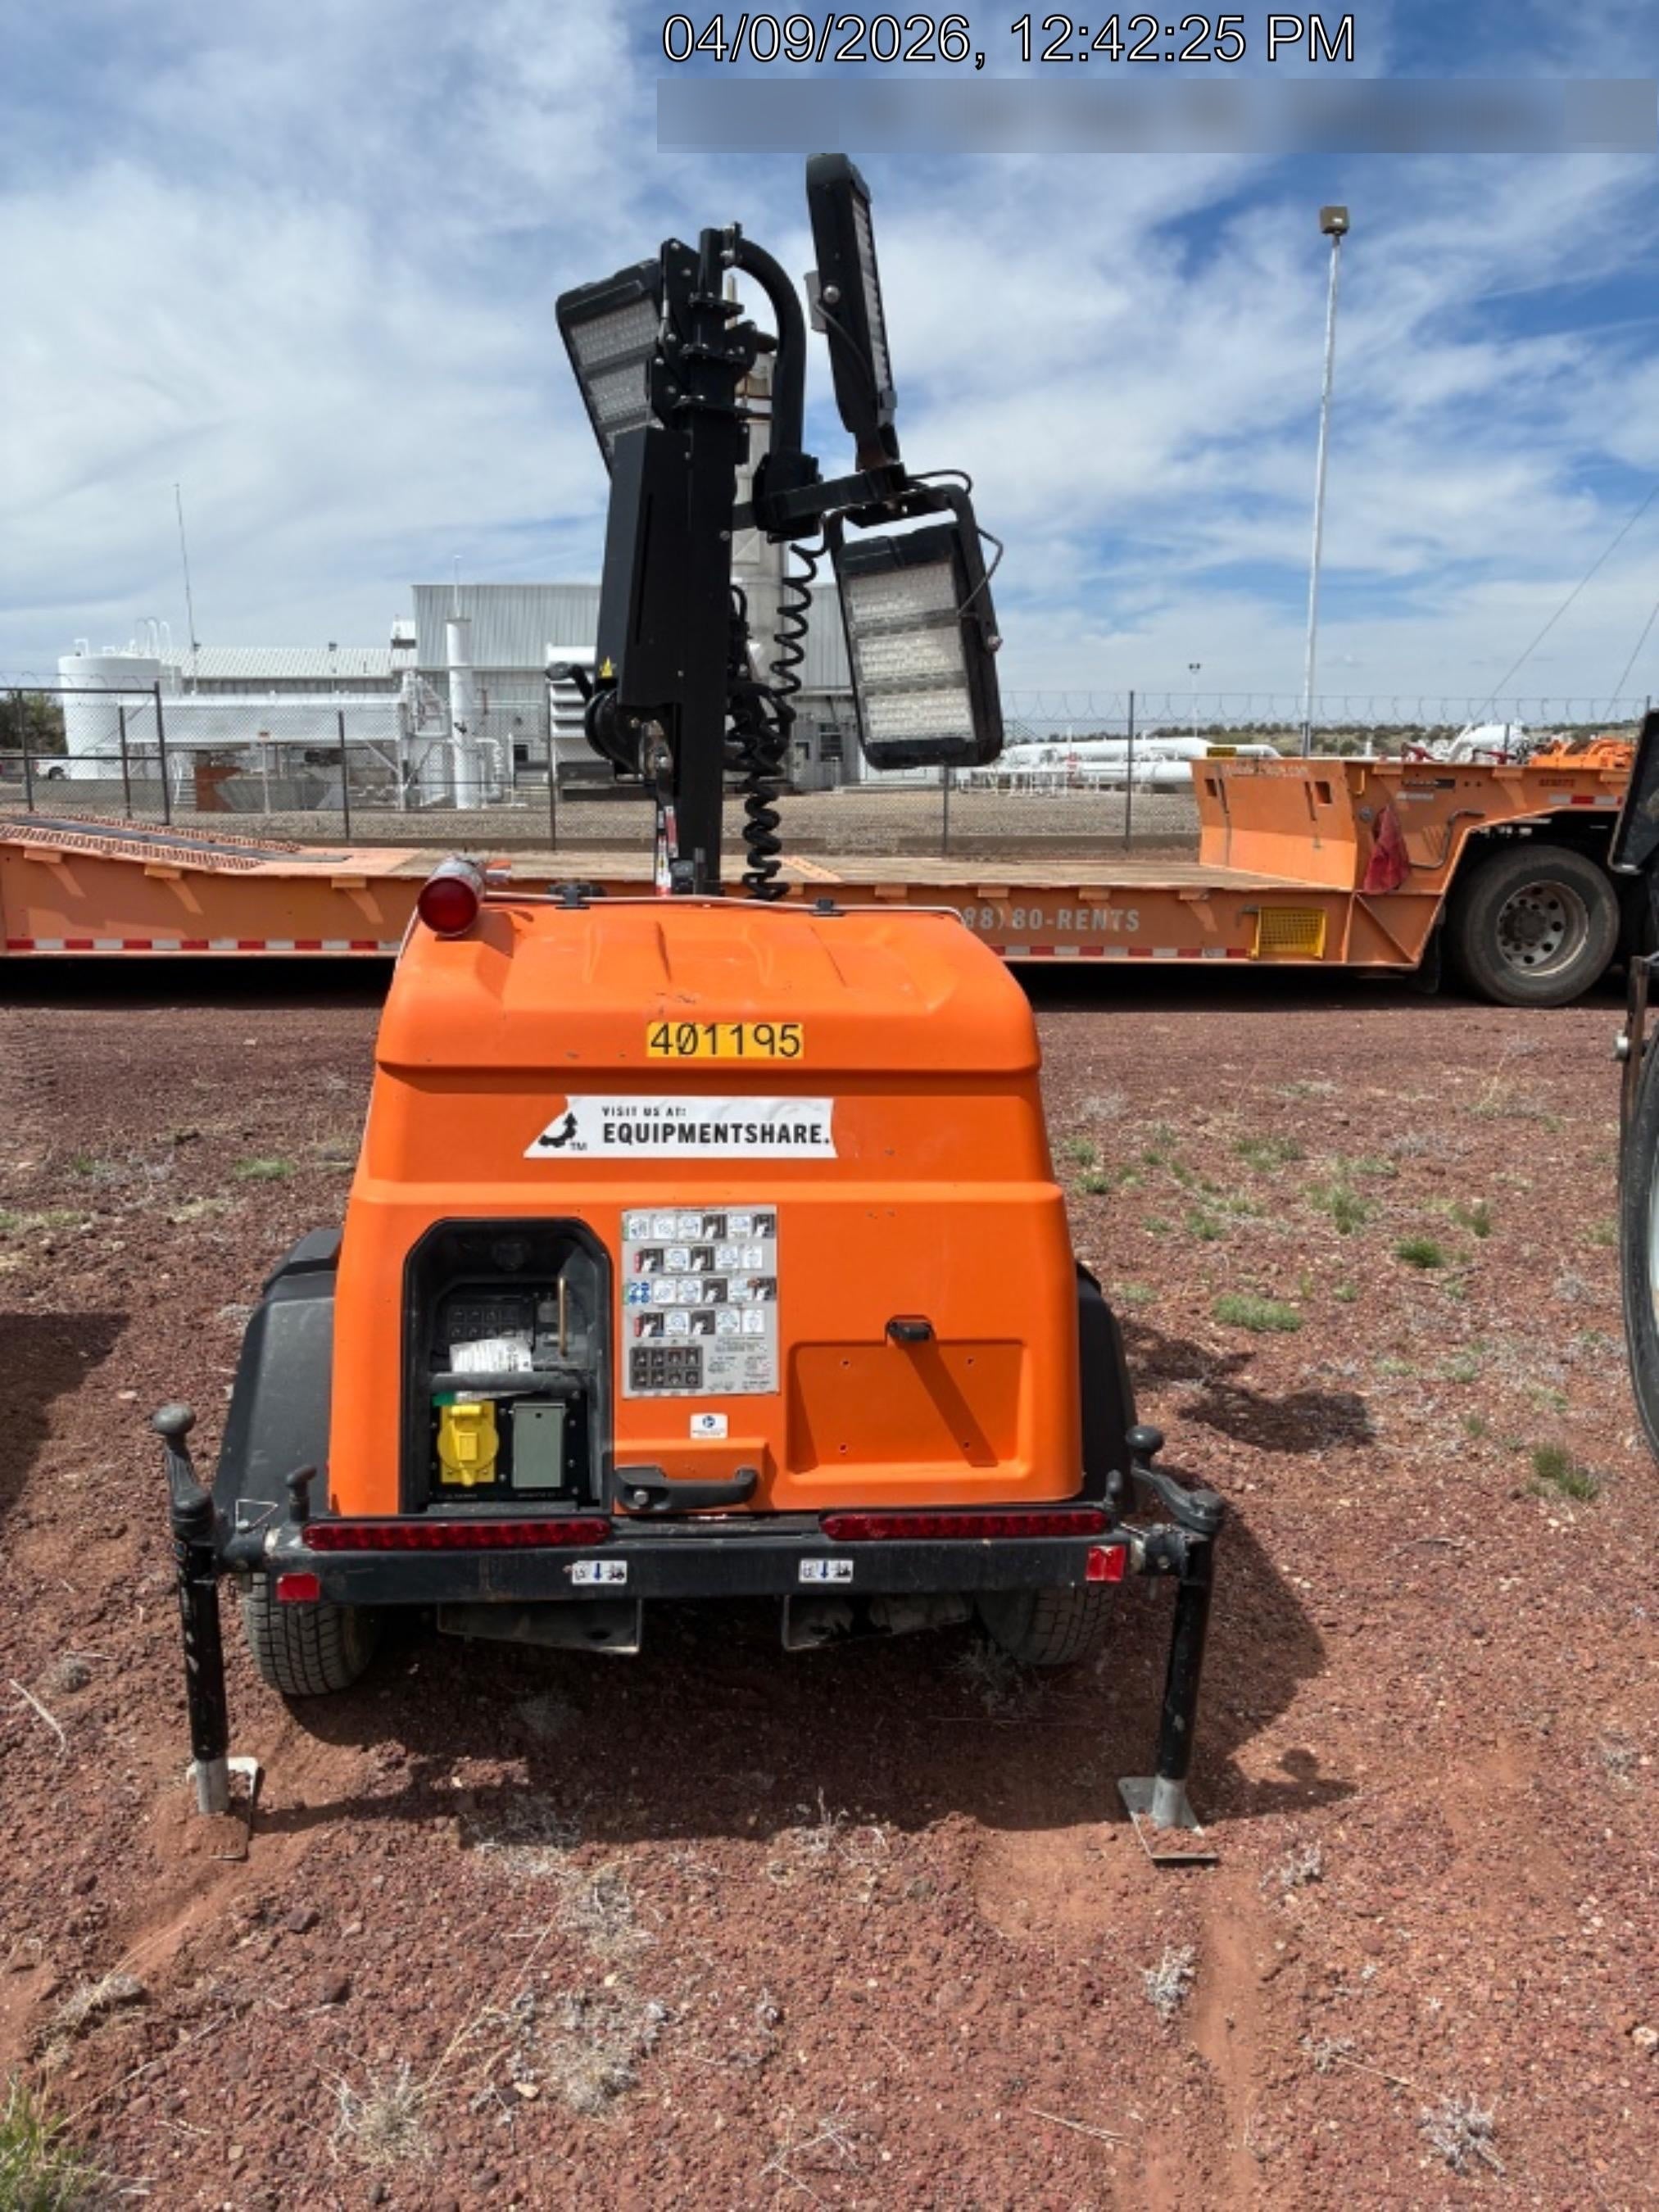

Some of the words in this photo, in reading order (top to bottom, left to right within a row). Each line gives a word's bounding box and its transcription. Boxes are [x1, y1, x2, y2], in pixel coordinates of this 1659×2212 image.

[650, 1023, 801, 1057] 401195
[602, 1108, 637, 1116] VISIT
[644, 1108, 660, 1116] US
